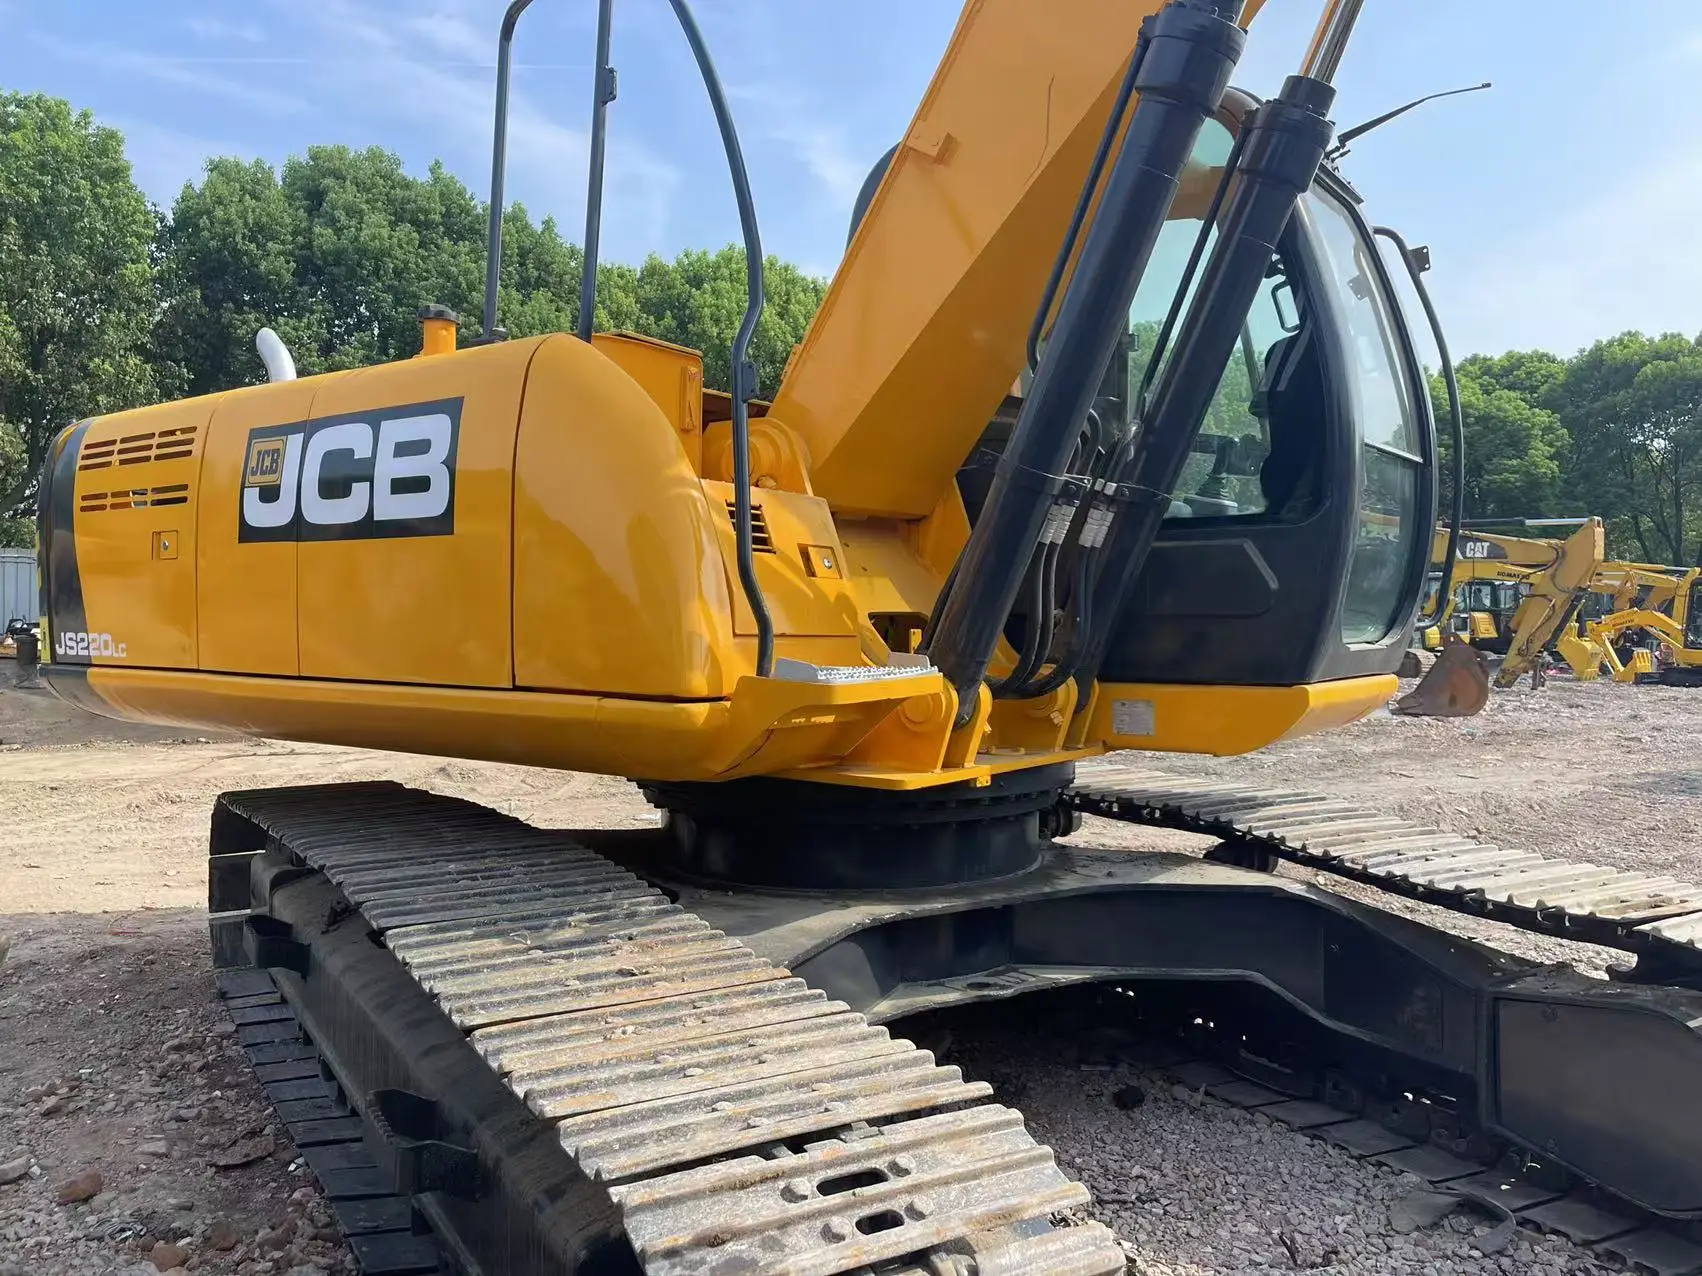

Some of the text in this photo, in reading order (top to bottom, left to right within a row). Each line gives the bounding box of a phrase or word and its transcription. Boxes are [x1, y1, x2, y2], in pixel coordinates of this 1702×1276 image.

[243, 414, 452, 528] JCB
[250, 448, 281, 476] JCB
[1466, 541, 1490, 558] CAT
